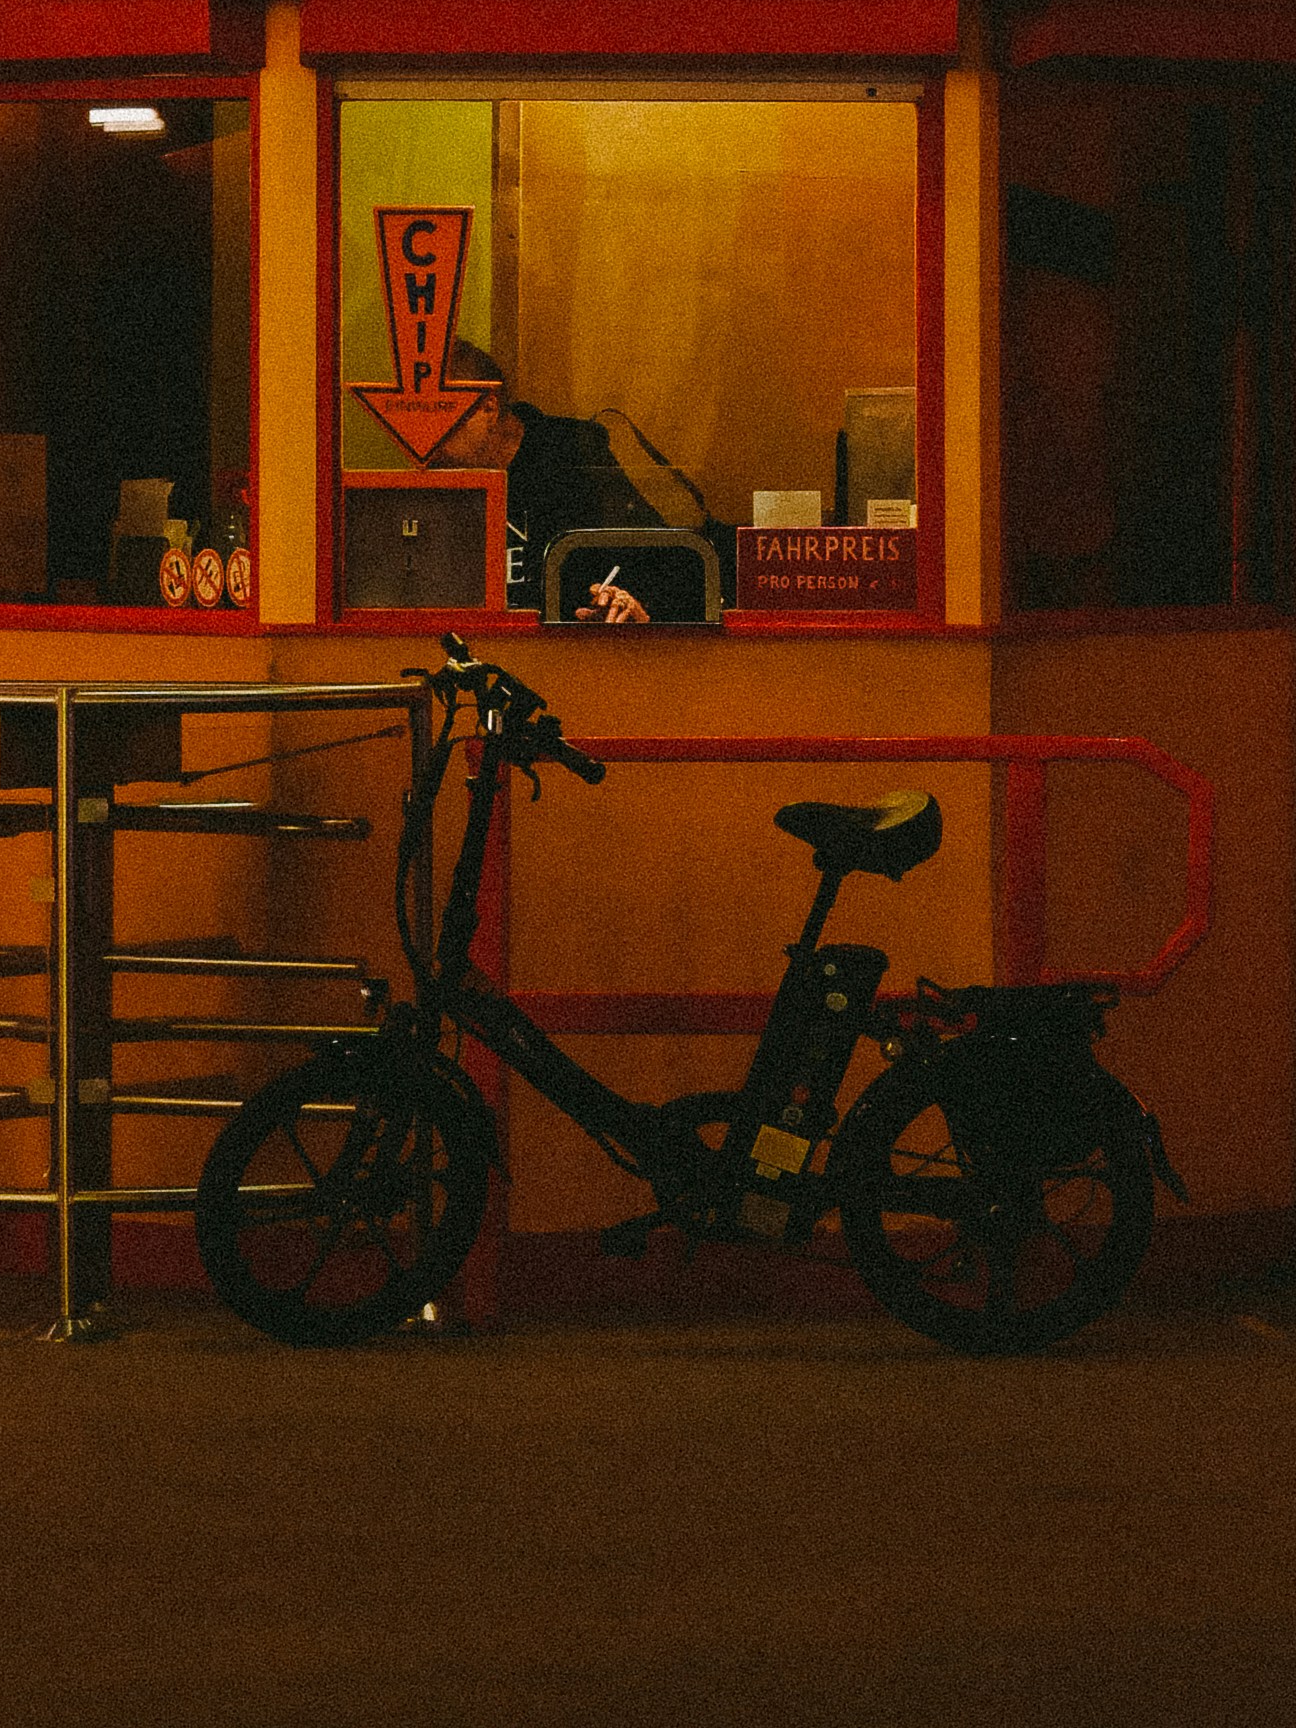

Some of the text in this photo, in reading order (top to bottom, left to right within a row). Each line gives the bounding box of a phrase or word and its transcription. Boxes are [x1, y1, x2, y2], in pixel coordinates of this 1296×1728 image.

[401, 218, 438, 393] CHIP
[756, 535, 901, 561] FAHRPREIS
[757, 575, 791, 590] PRO
[796, 575, 860, 590] PERSON
